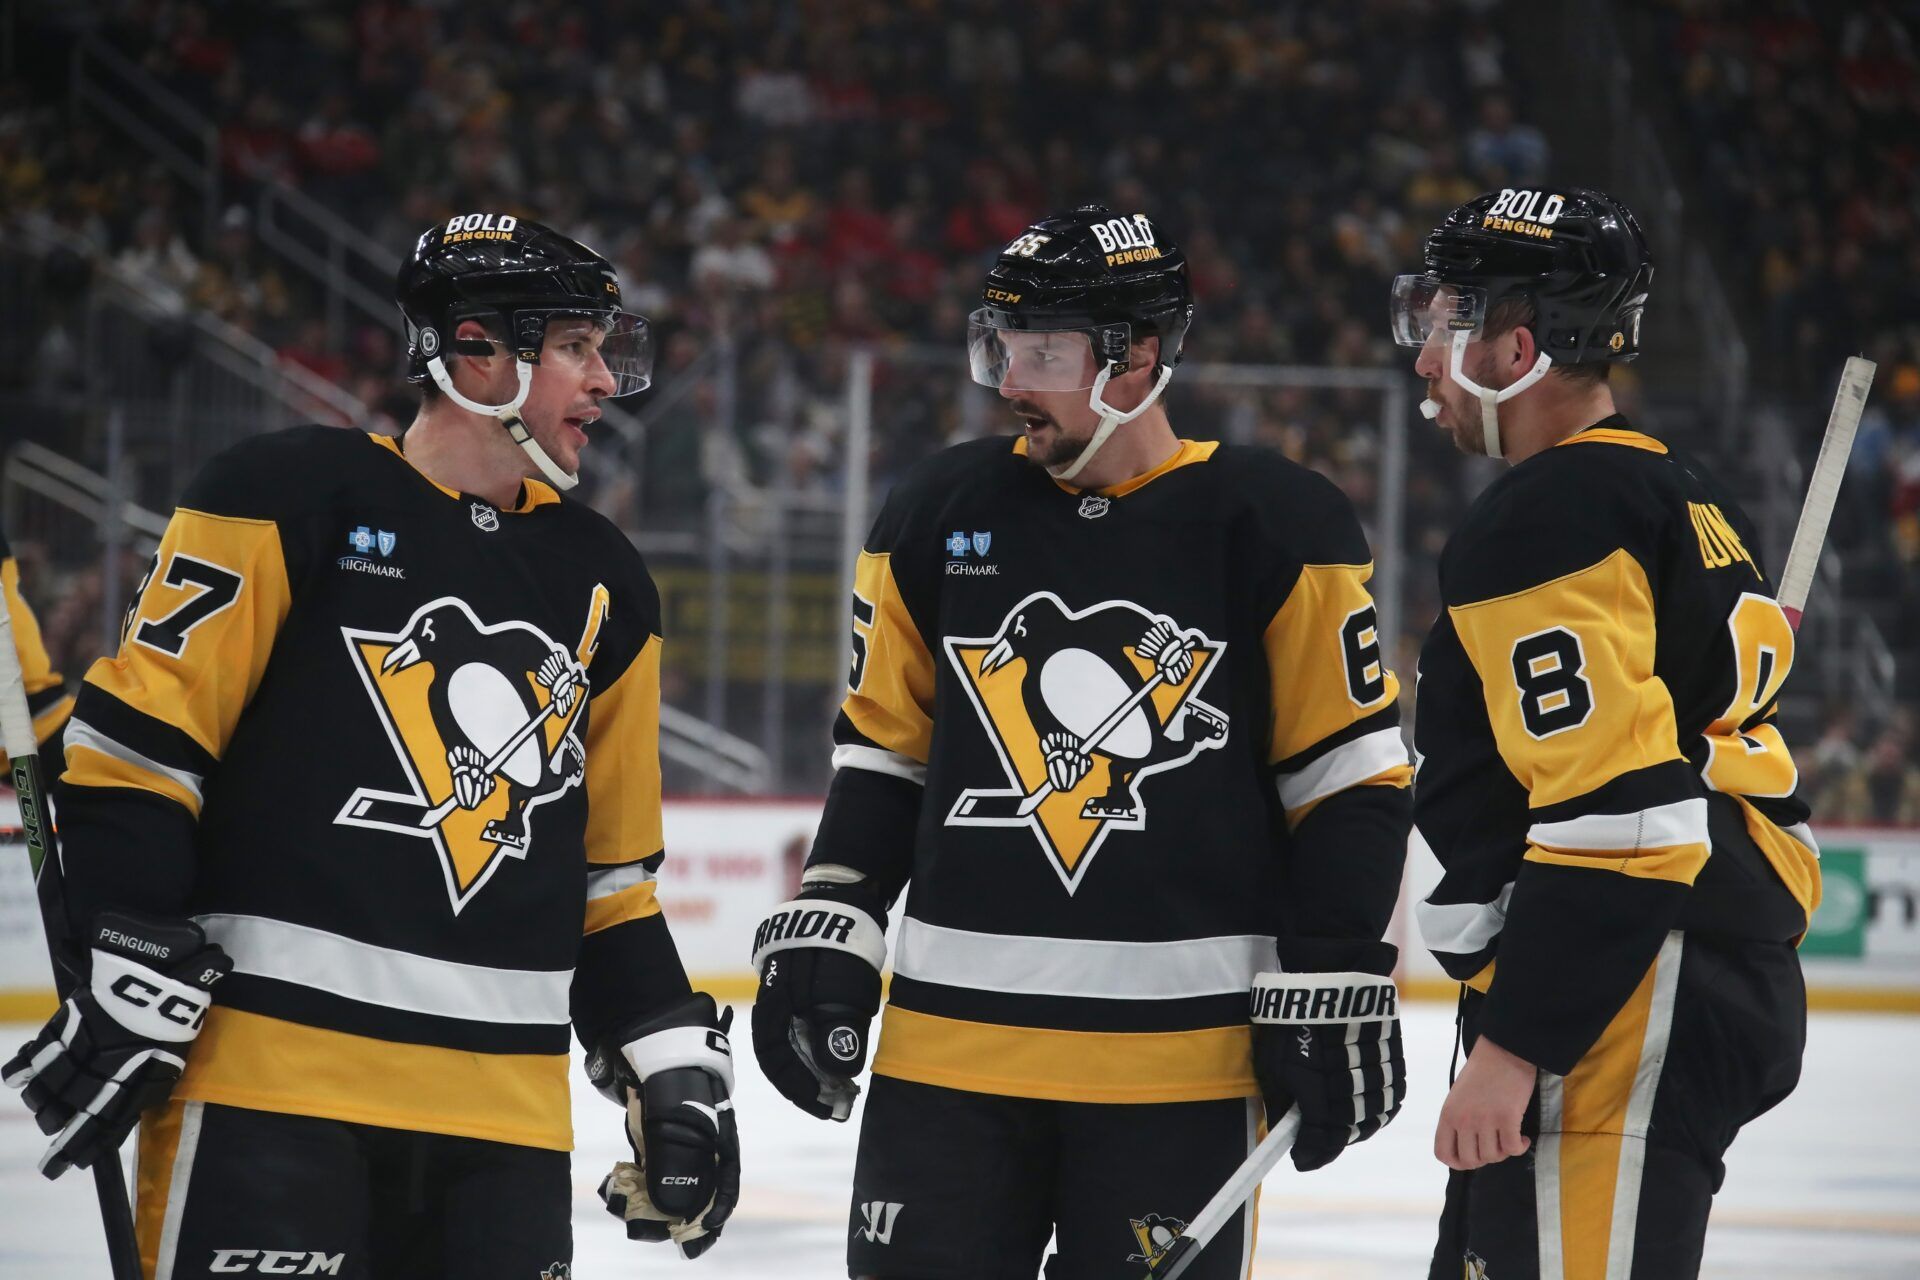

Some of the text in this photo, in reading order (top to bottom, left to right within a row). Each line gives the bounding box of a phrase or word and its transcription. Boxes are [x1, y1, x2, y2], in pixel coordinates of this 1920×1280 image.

[1487, 188, 1566, 225] BOLD
[445, 213, 518, 235] BOLD
[1090, 213, 1155, 253] BOLD
[1482, 215, 1554, 239] PENGUIN
[442, 231, 513, 245] PENGUIN
[1106, 246, 1162, 267] PENGUIN
[987, 288, 1021, 303] CCM
[478, 513, 492, 525] NHL
[338, 557, 404, 579] HIGHMARK
[1510, 625, 1596, 741] 8
[14, 766, 43, 849] CCM
[99, 928, 171, 960] PENGUINS
[751, 909, 857, 966] RRIOR
[199, 968, 224, 986] 87
[661, 1176, 699, 1186] CCM
[208, 1249, 346, 1276] CCM
